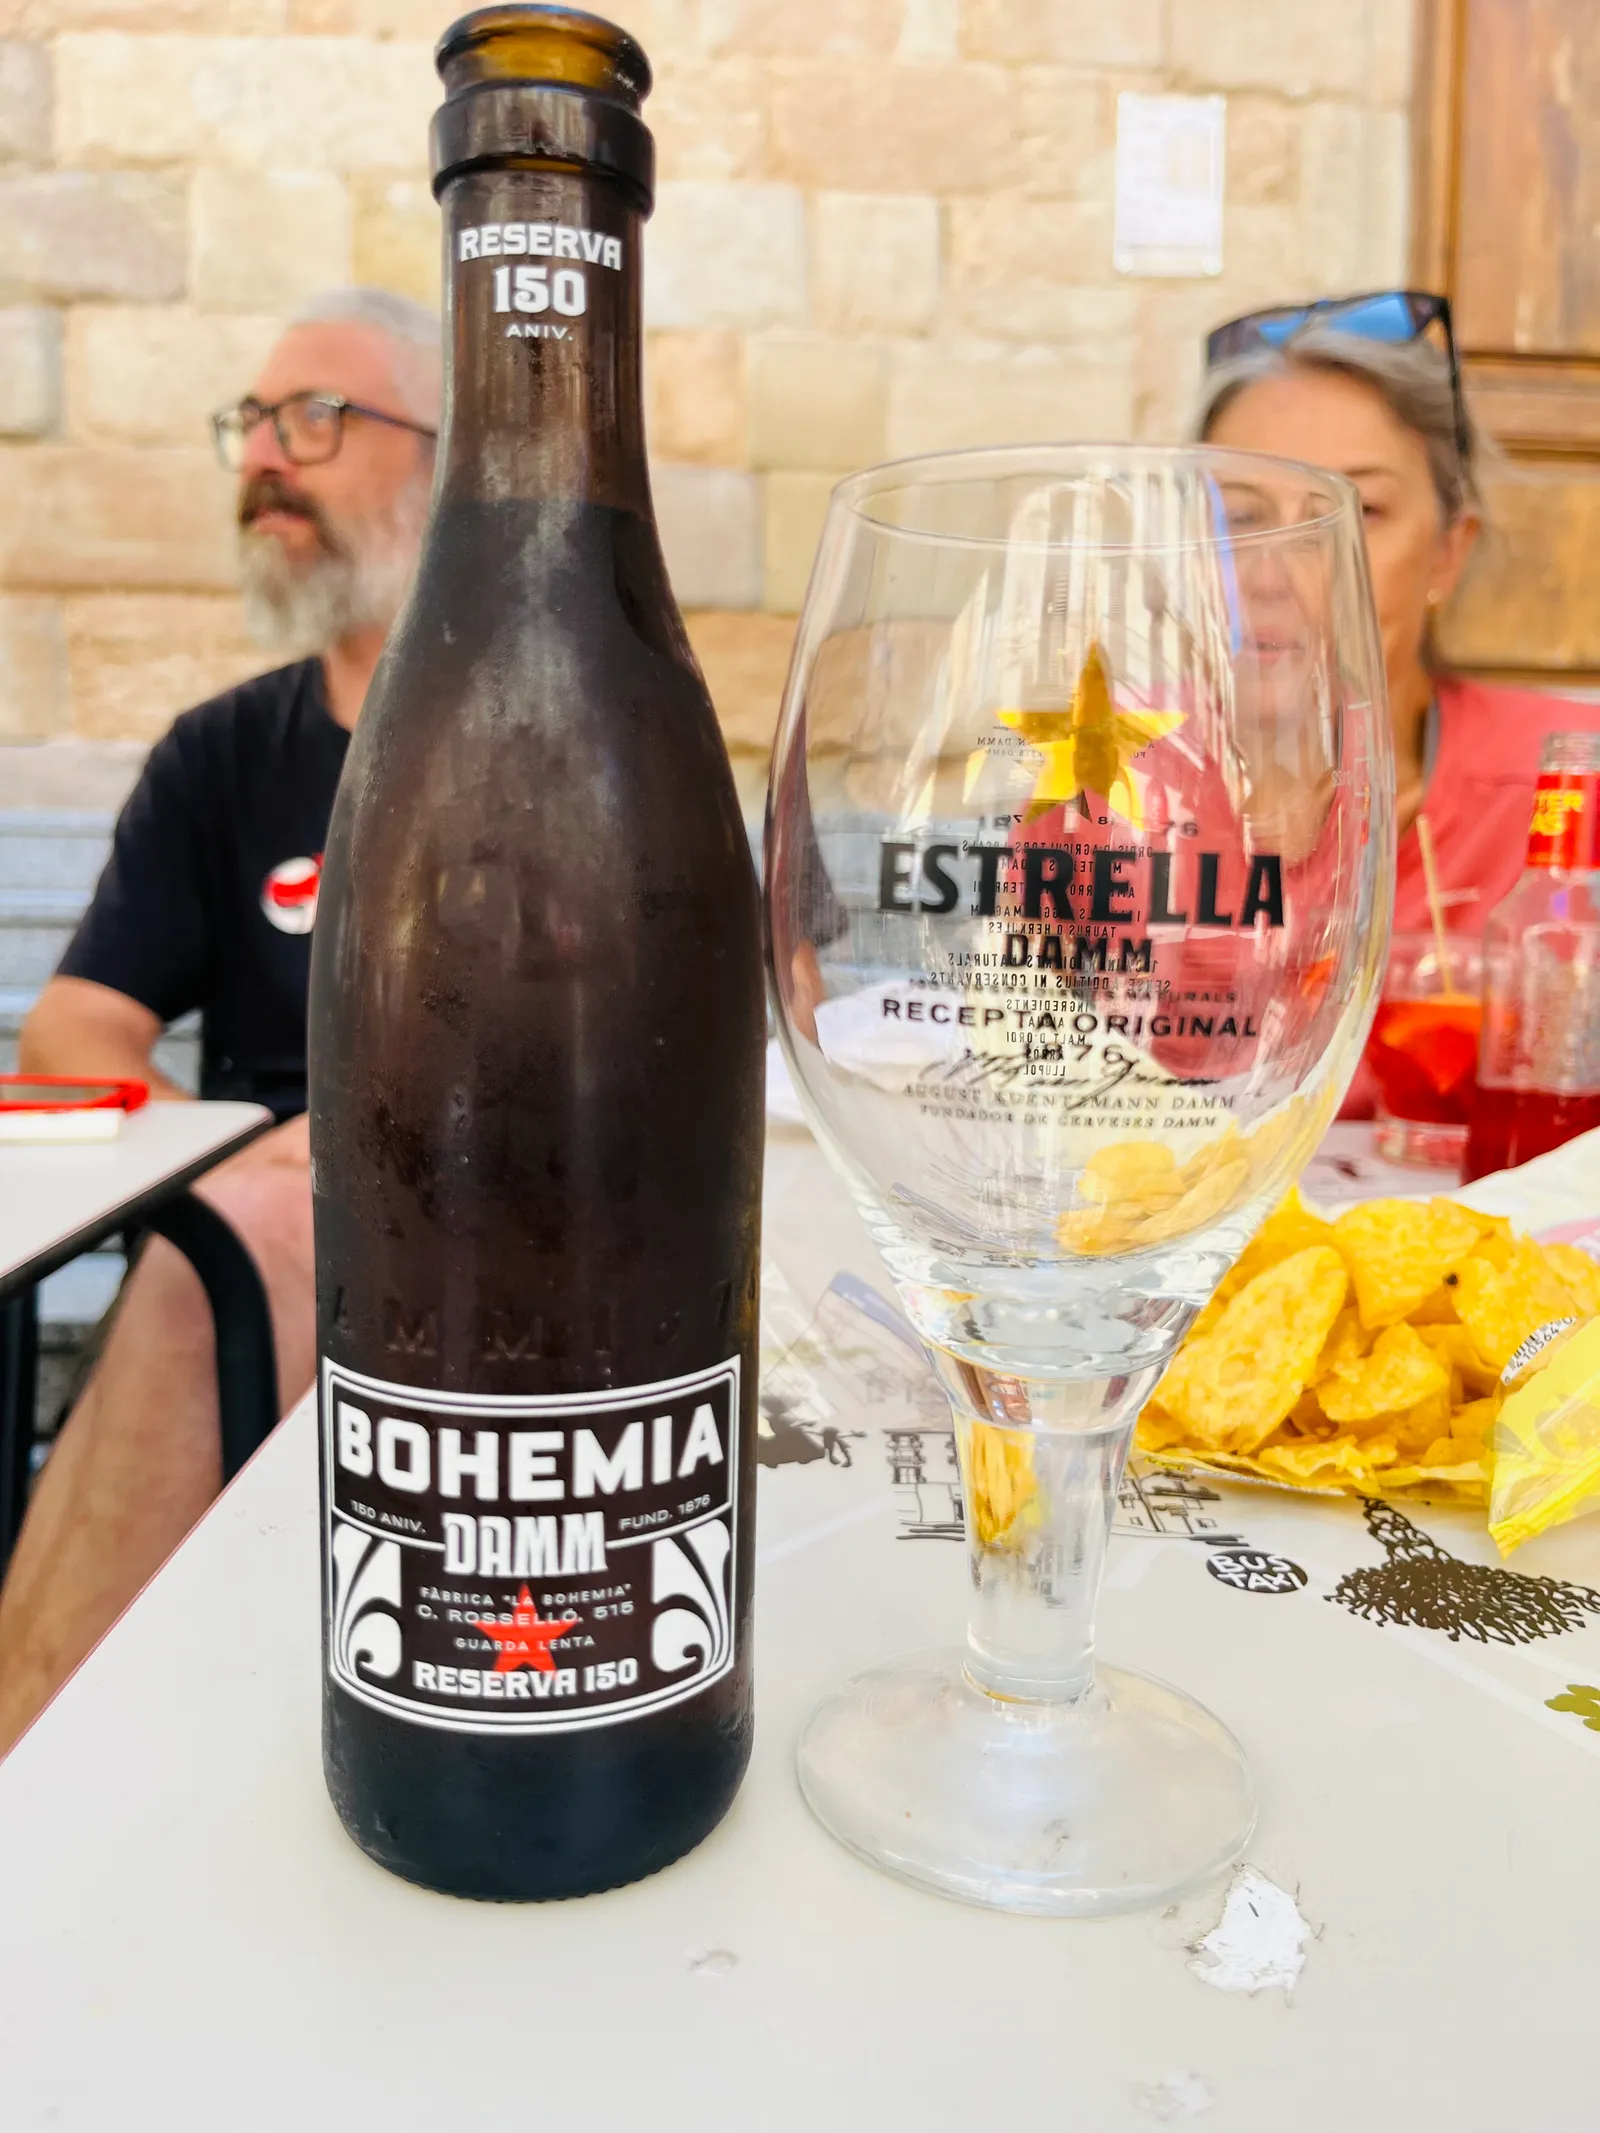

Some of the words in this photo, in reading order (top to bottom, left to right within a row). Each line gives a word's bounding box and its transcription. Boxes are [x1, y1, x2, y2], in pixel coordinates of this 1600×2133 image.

[459, 223, 622, 272] RESERVA
[494, 265, 587, 317] 150
[505, 323, 575, 342] ANIV.
[877, 841, 1285, 928] ESTRELLA
[1003, 932, 1156, 971] DAMM
[882, 999, 1063, 1031] RECEPTA
[1072, 1012, 1259, 1038] ORIGINAL
[1162, 1115, 1218, 1128] DAMM
[1171, 1095, 1235, 1110] DAMM
[337, 1400, 725, 1501] BOHEMIA
[350, 1498, 377, 1520] 150
[380, 1510, 427, 1534] ANIV.
[618, 1509, 675, 1531] FUND.
[677, 1493, 712, 1516] 1876
[441, 1511, 609, 1578] DAMM
[1209, 1555, 1292, 1574] BUS
[1216, 1572, 1303, 1592] TAXI
[415, 1604, 438, 1620] C.
[593, 1600, 634, 1619] 515
[454, 1636, 530, 1652] GUARDA
[539, 1635, 596, 1651] LENTA
[412, 1660, 577, 1699] RESERVA
[582, 1656, 639, 1693] 150
